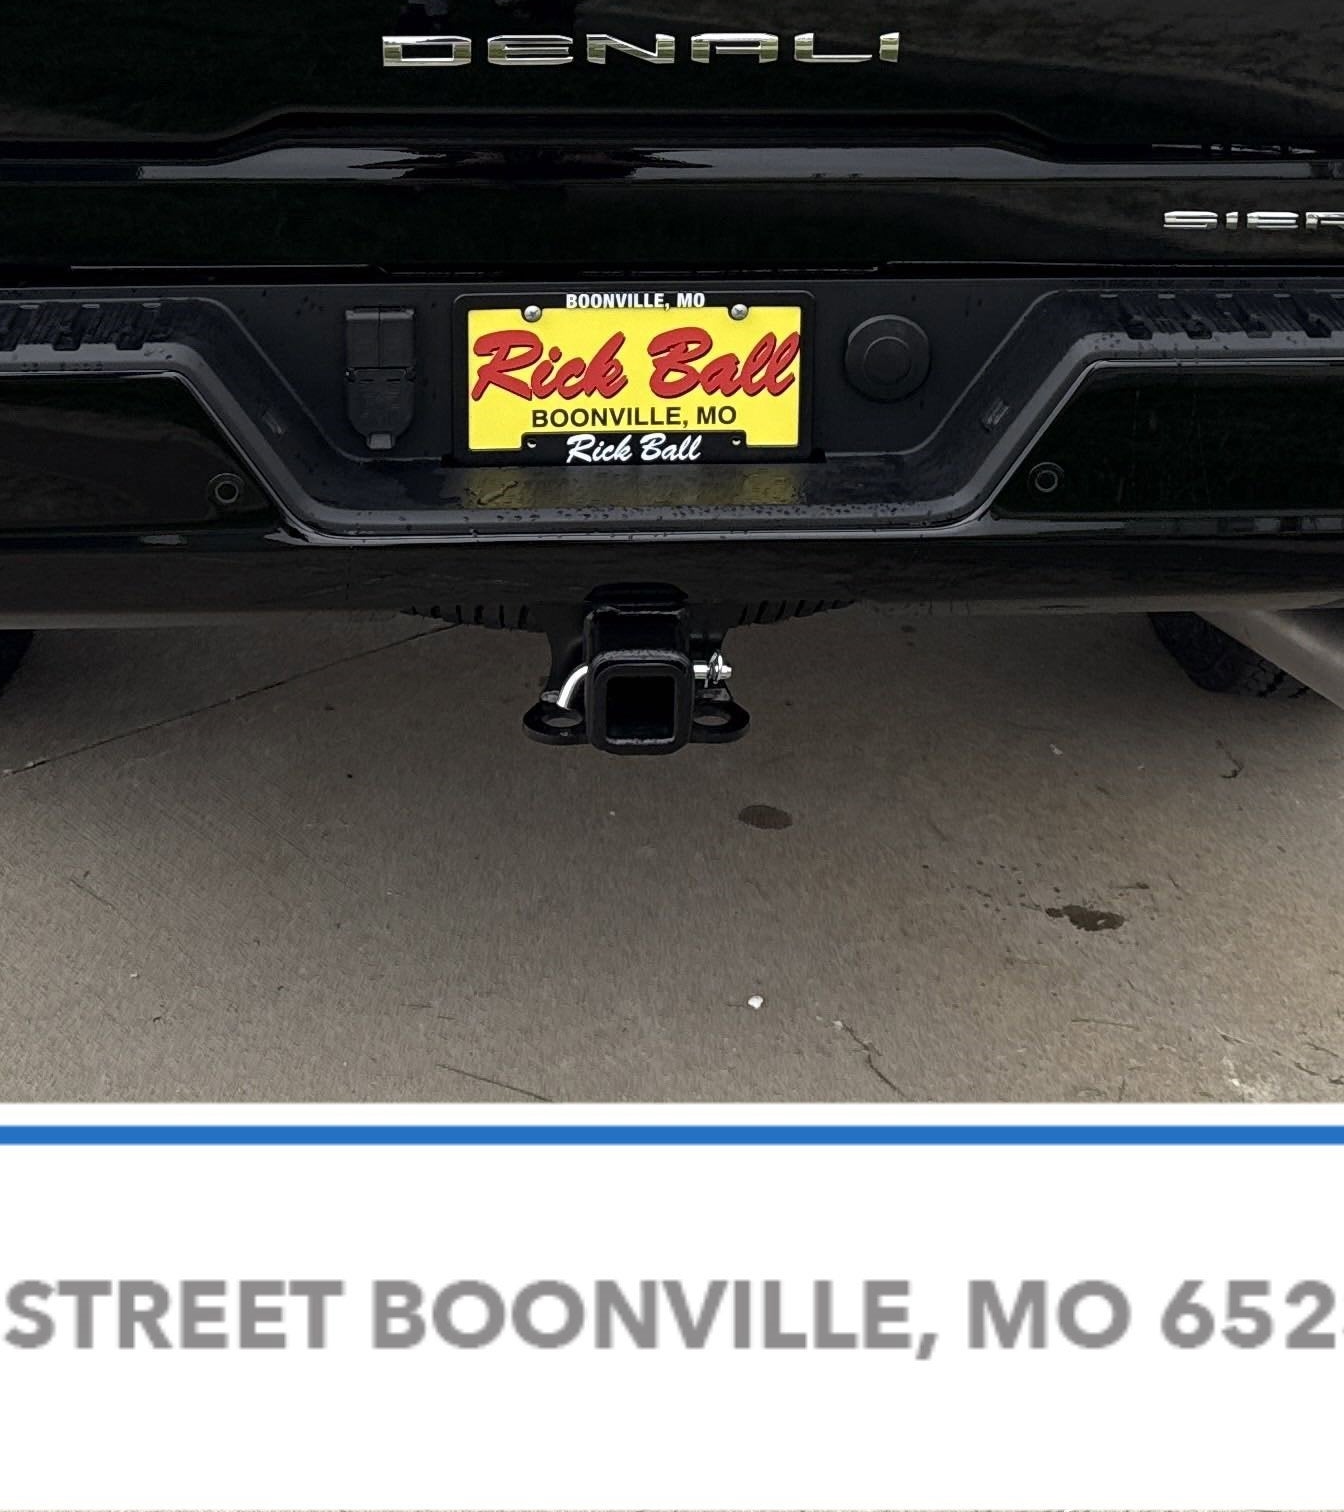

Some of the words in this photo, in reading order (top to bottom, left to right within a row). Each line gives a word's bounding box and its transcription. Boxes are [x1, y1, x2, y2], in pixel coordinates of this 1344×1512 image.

[382, 31, 900, 67] DENALI
[565, 293, 670, 310] BOONVILLE,
[677, 292, 706, 308] MO
[471, 329, 629, 401] Rick
[647, 327, 800, 399] Ball
[531, 407, 689, 428] BOONVILLE,
[696, 405, 737, 425] MO
[566, 433, 633, 464] Rick
[639, 432, 702, 462] Ball
